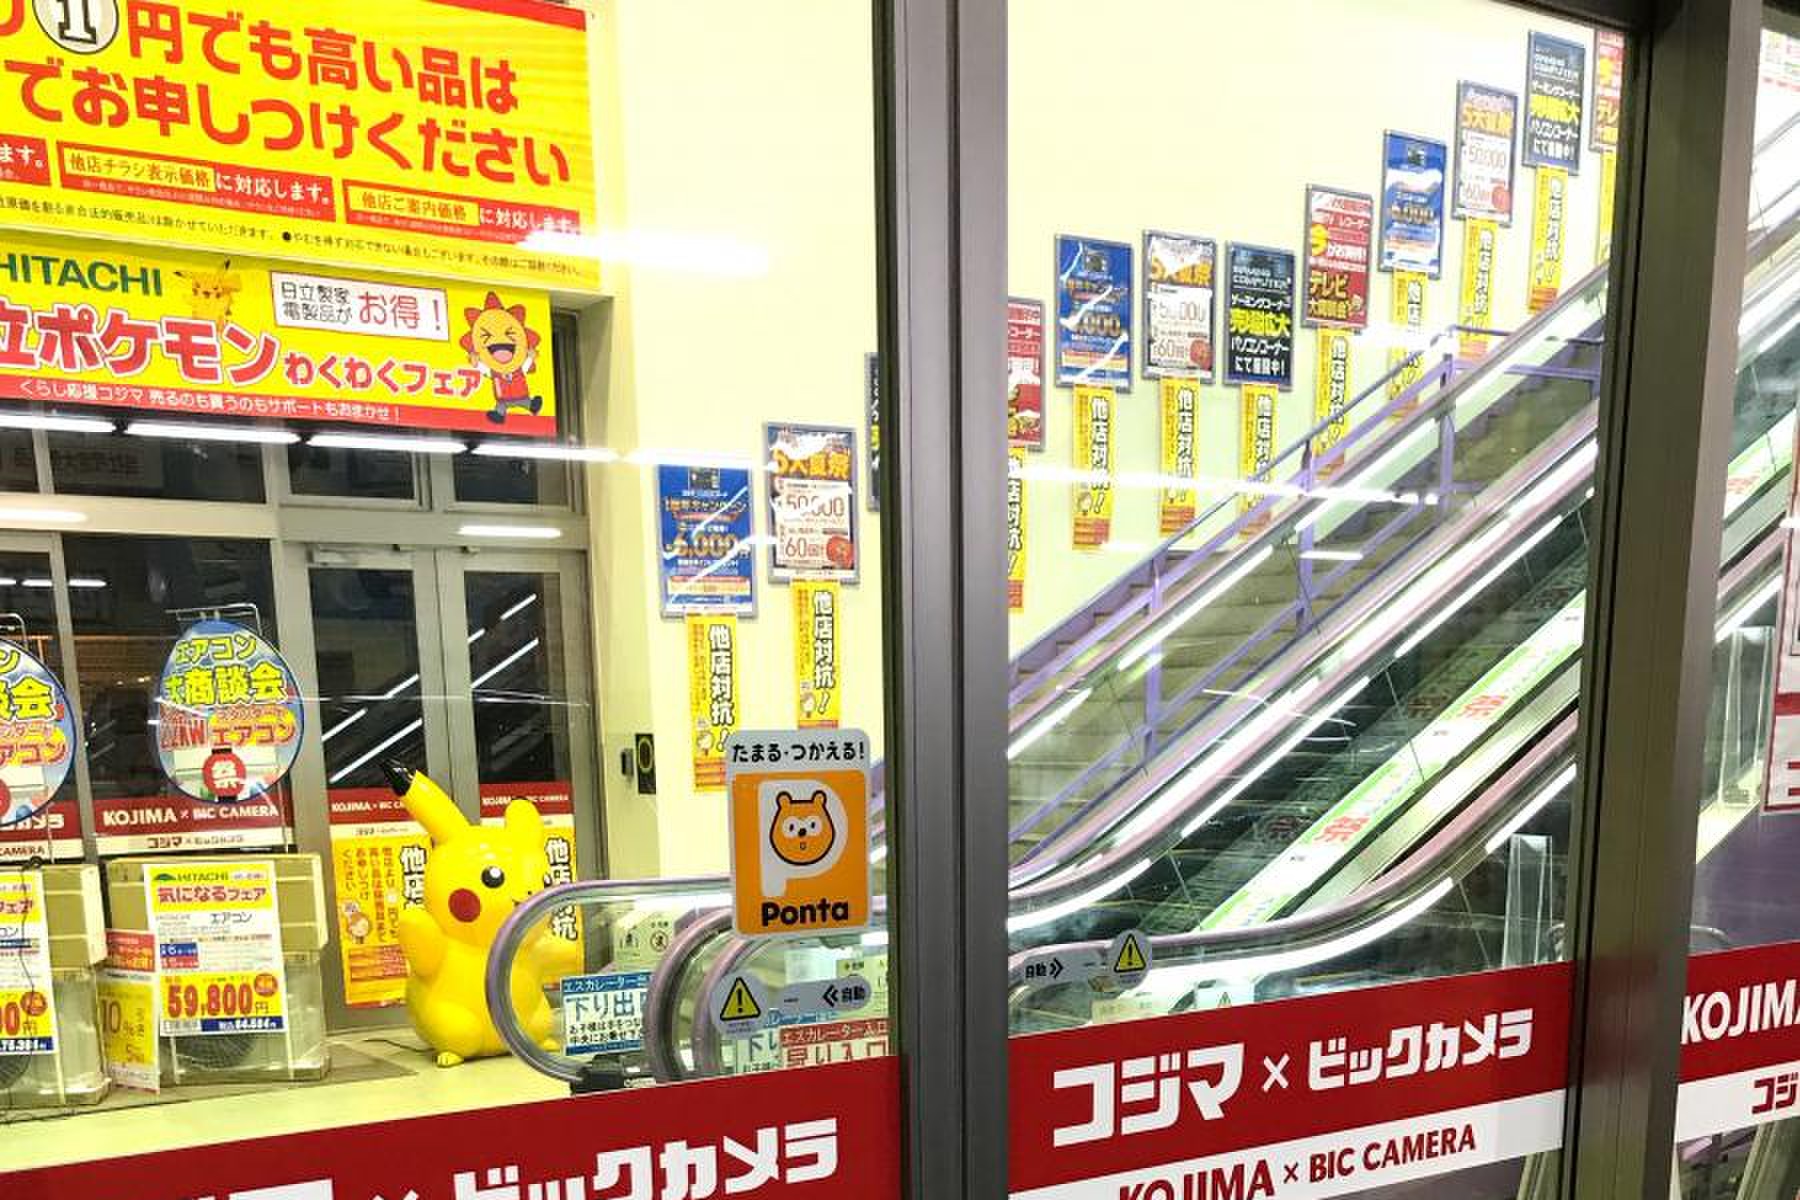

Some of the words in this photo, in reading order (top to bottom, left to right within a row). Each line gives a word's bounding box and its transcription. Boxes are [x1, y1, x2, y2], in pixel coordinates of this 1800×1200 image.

[4, 57, 571, 186] でお申しつけください
[0, 253, 163, 296] HITACHI
[284, 351, 485, 398] わくわくフェア
[102, 806, 177, 827] KOJIMA
[219, 804, 280, 819] CAMERA
[157, 885, 267, 903] 気になるフェア
[761, 898, 849, 927] Ponta
[210, 911, 253, 925] エアコン
[565, 989, 645, 1023] 下り出
[1680, 978, 1800, 1046] KOJIM
[1051, 1042, 1245, 1148] コジマ
[1308, 1007, 1534, 1091] ビックカメラ
[1309, 1143, 1357, 1185] BIC
[1362, 1123, 1478, 1175] CAMERA
